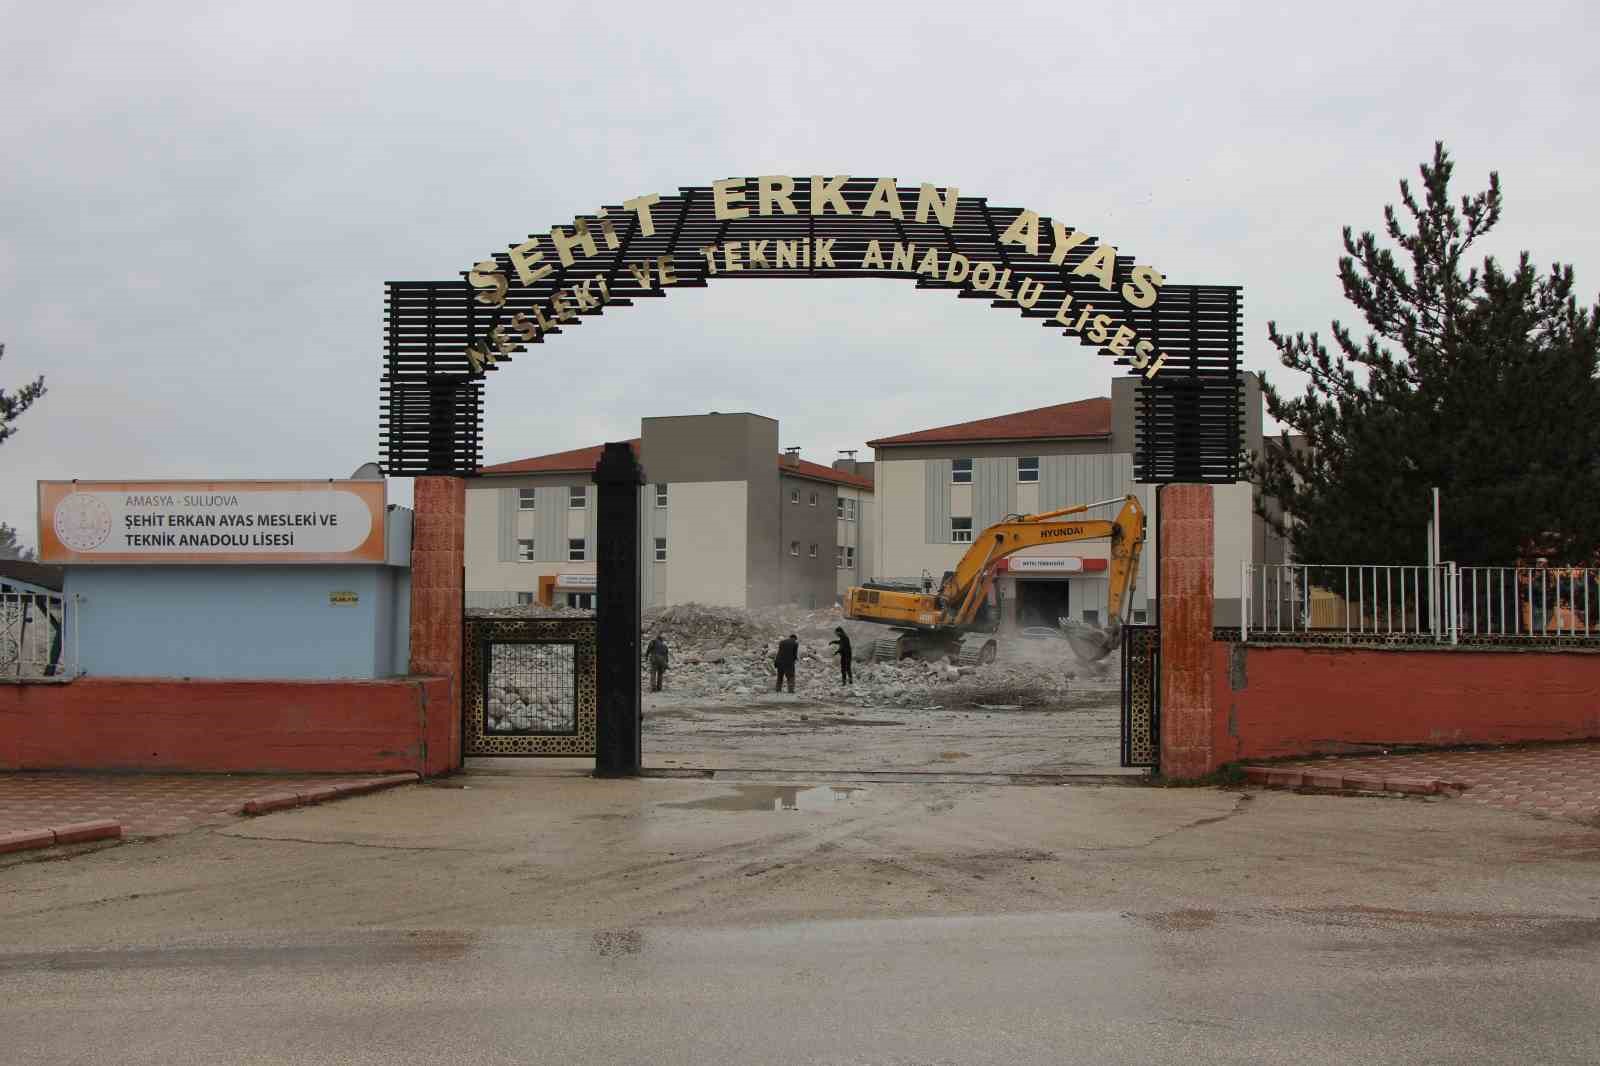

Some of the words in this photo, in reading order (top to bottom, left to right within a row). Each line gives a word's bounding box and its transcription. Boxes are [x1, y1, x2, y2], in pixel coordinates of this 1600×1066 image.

[712, 175, 960, 228] ERKAN
[998, 208, 1164, 309] AYAS
[629, 255, 677, 289] VE
[700, 237, 836, 274] TEKNİK
[861, 239, 1044, 309] ANADOLU
[1056, 294, 1168, 378] LİSESİ
[126, 495, 174, 506] AMASYA
[184, 495, 239, 506] SULUOVA
[125, 512, 165, 529] ŞEHİT
[168, 514, 215, 527] ERKAN
[219, 514, 254, 527] AYAS
[257, 512, 317, 527] MESLEKİ
[319, 514, 338, 527] VE
[125, 532, 176, 546] TEKNİK
[179, 534, 249, 546] ANADOLU
[252, 532, 294, 546] LİSESİ
[1040, 527, 1084, 538] HYUNDAI
